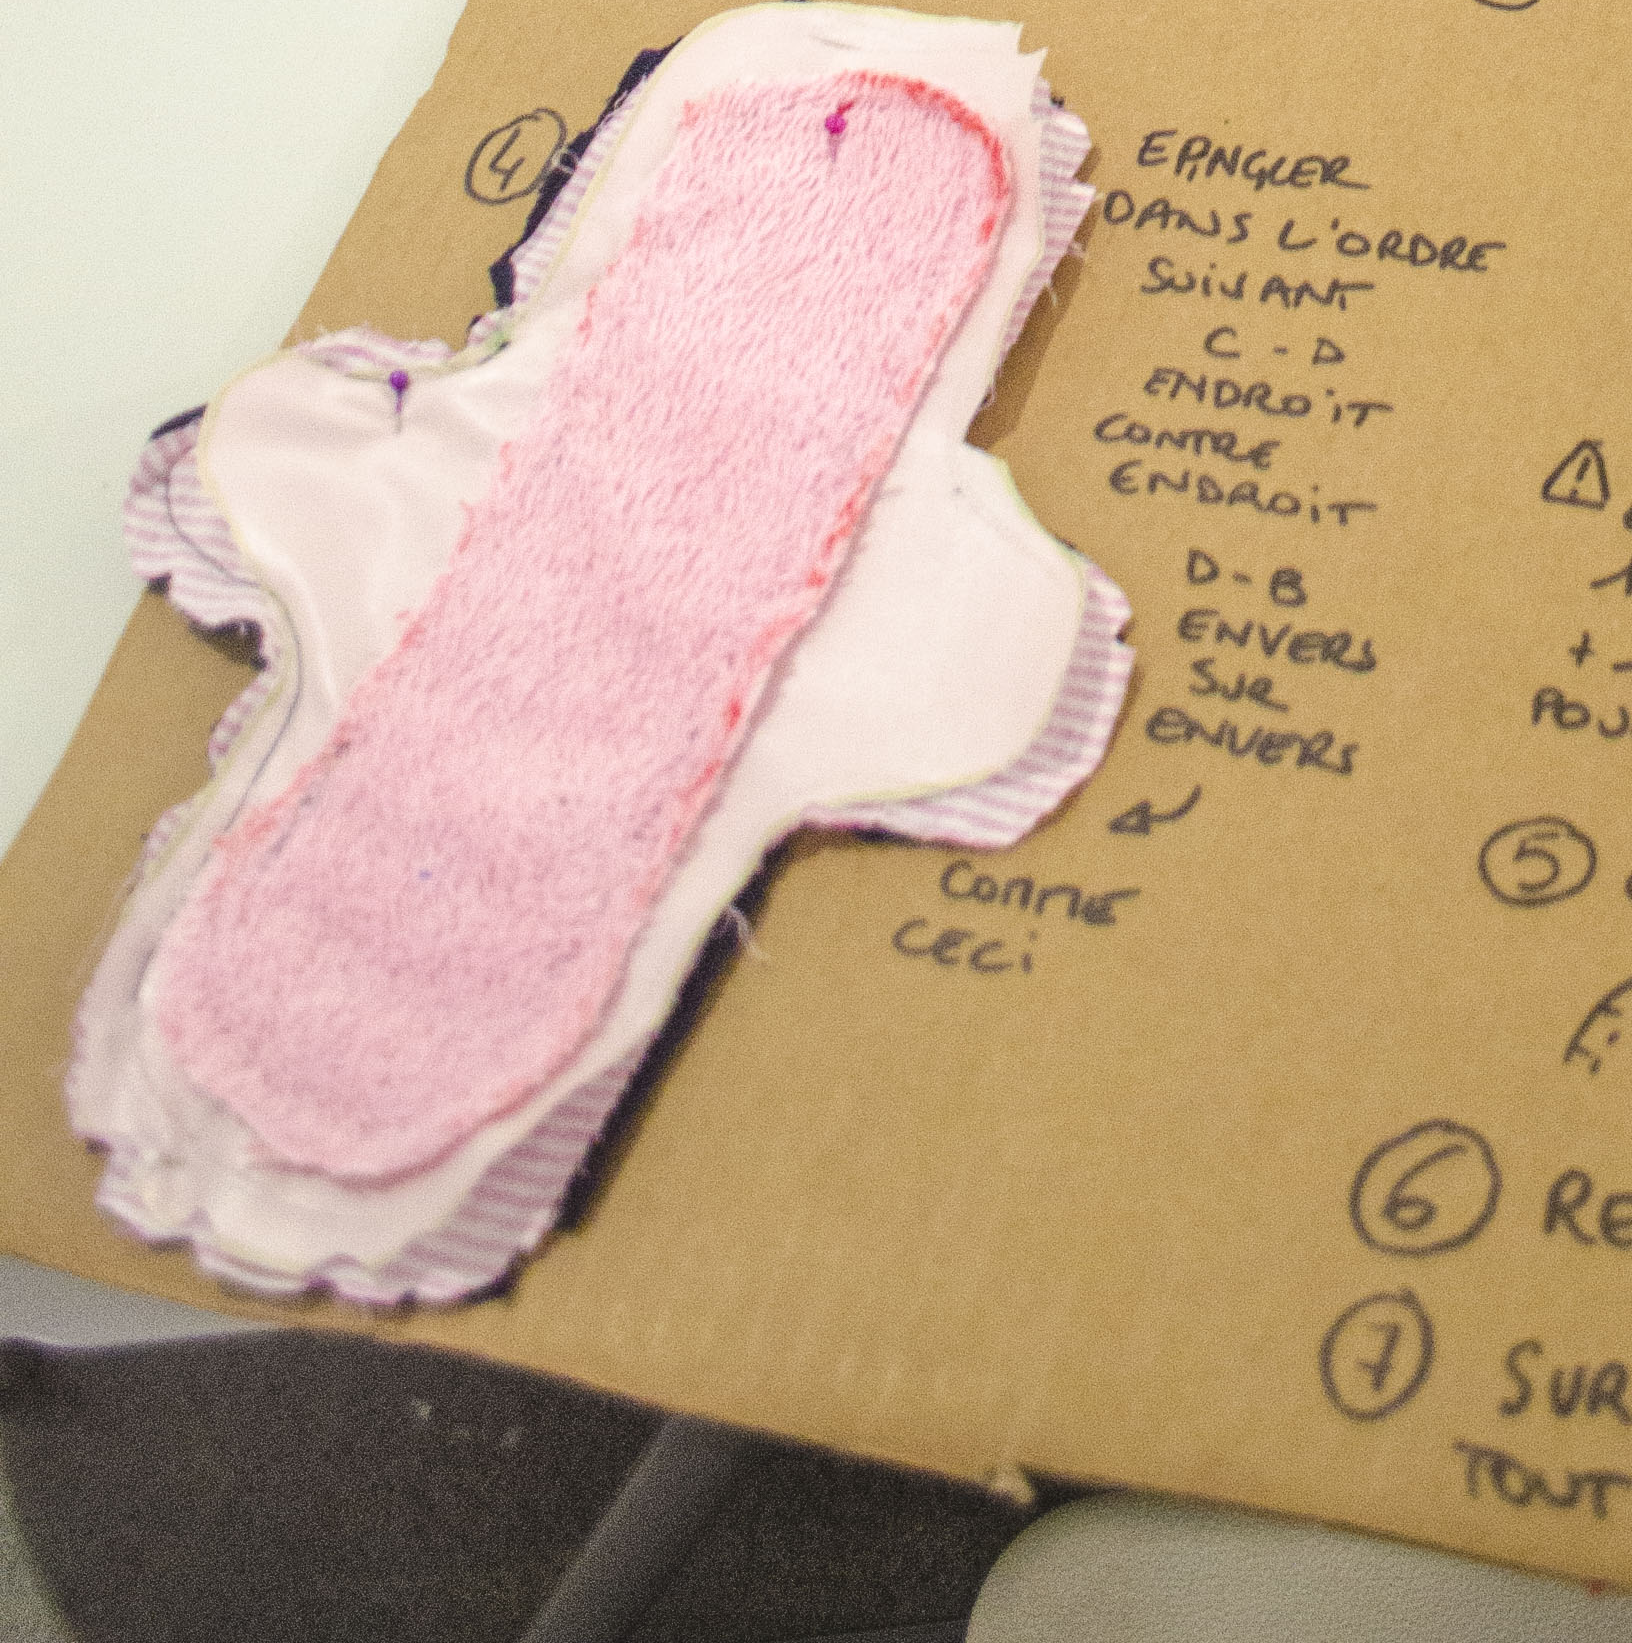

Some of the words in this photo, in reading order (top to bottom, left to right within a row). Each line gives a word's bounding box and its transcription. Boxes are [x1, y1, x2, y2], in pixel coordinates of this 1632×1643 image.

[1102, 187, 1254, 246] DANS
[1278, 218, 1506, 272] L'ORDRE
[1094, 413, 1280, 470] CONTRE
[1177, 609, 1377, 674] ENVERS
[1190, 658, 1288, 713] SUR
[1145, 707, 1358, 776] ENVERS
